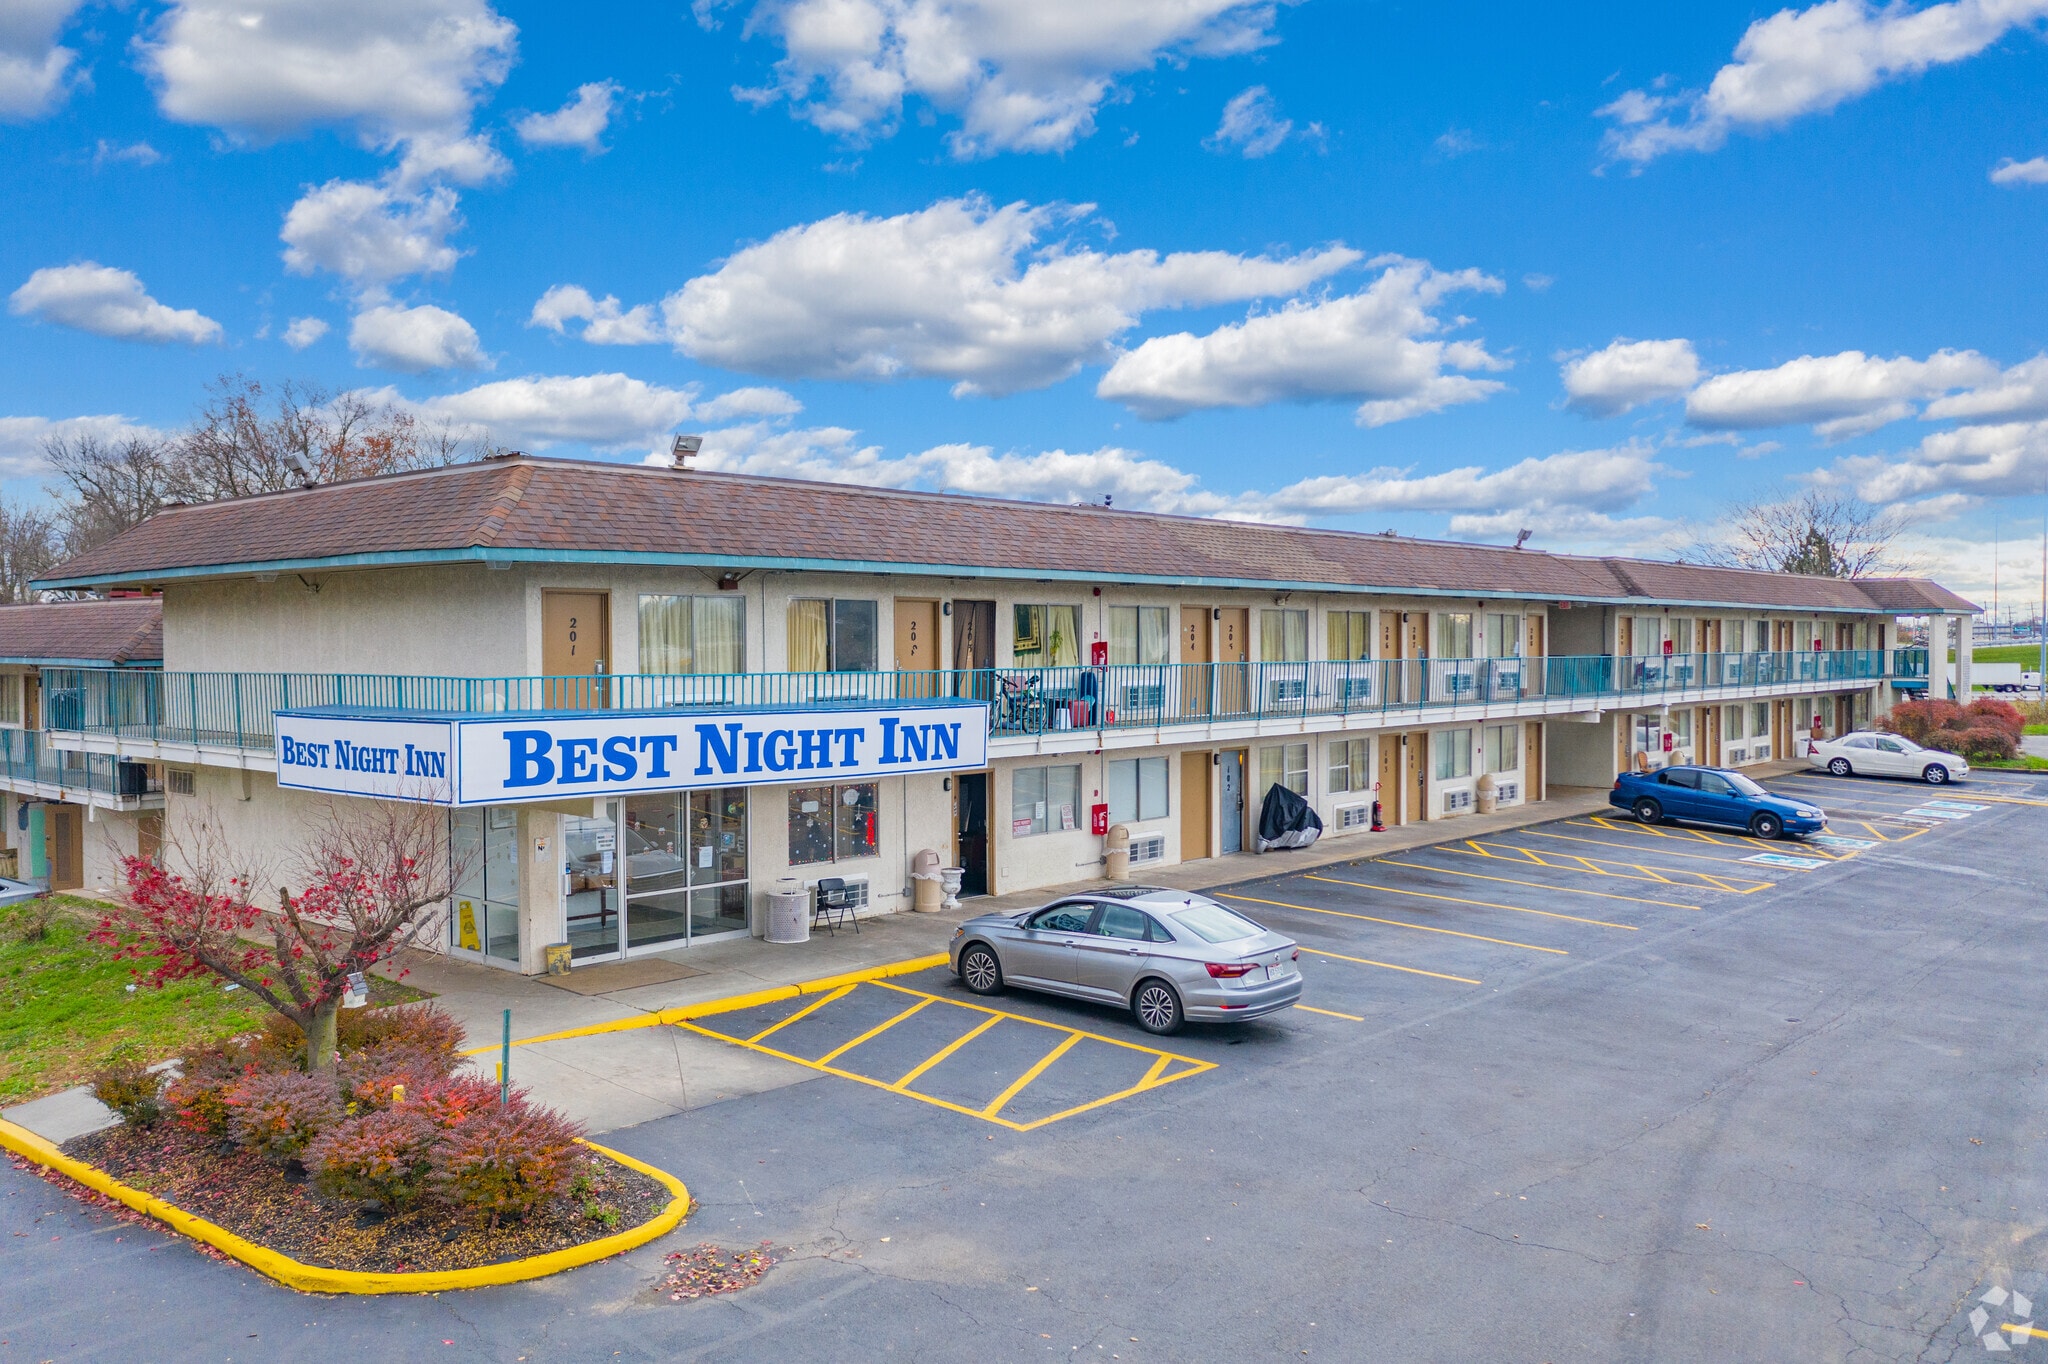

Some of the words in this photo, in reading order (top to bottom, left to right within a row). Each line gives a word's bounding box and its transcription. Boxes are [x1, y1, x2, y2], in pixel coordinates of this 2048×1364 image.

[569, 617, 577, 657] 201
[281, 735, 330, 769] BEST
[334, 739, 399, 775] NIGHT
[404, 743, 446, 779] INN
[503, 730, 677, 788] BEST
[694, 722, 865, 776] NIGHT
[878, 717, 962, 765] INN
